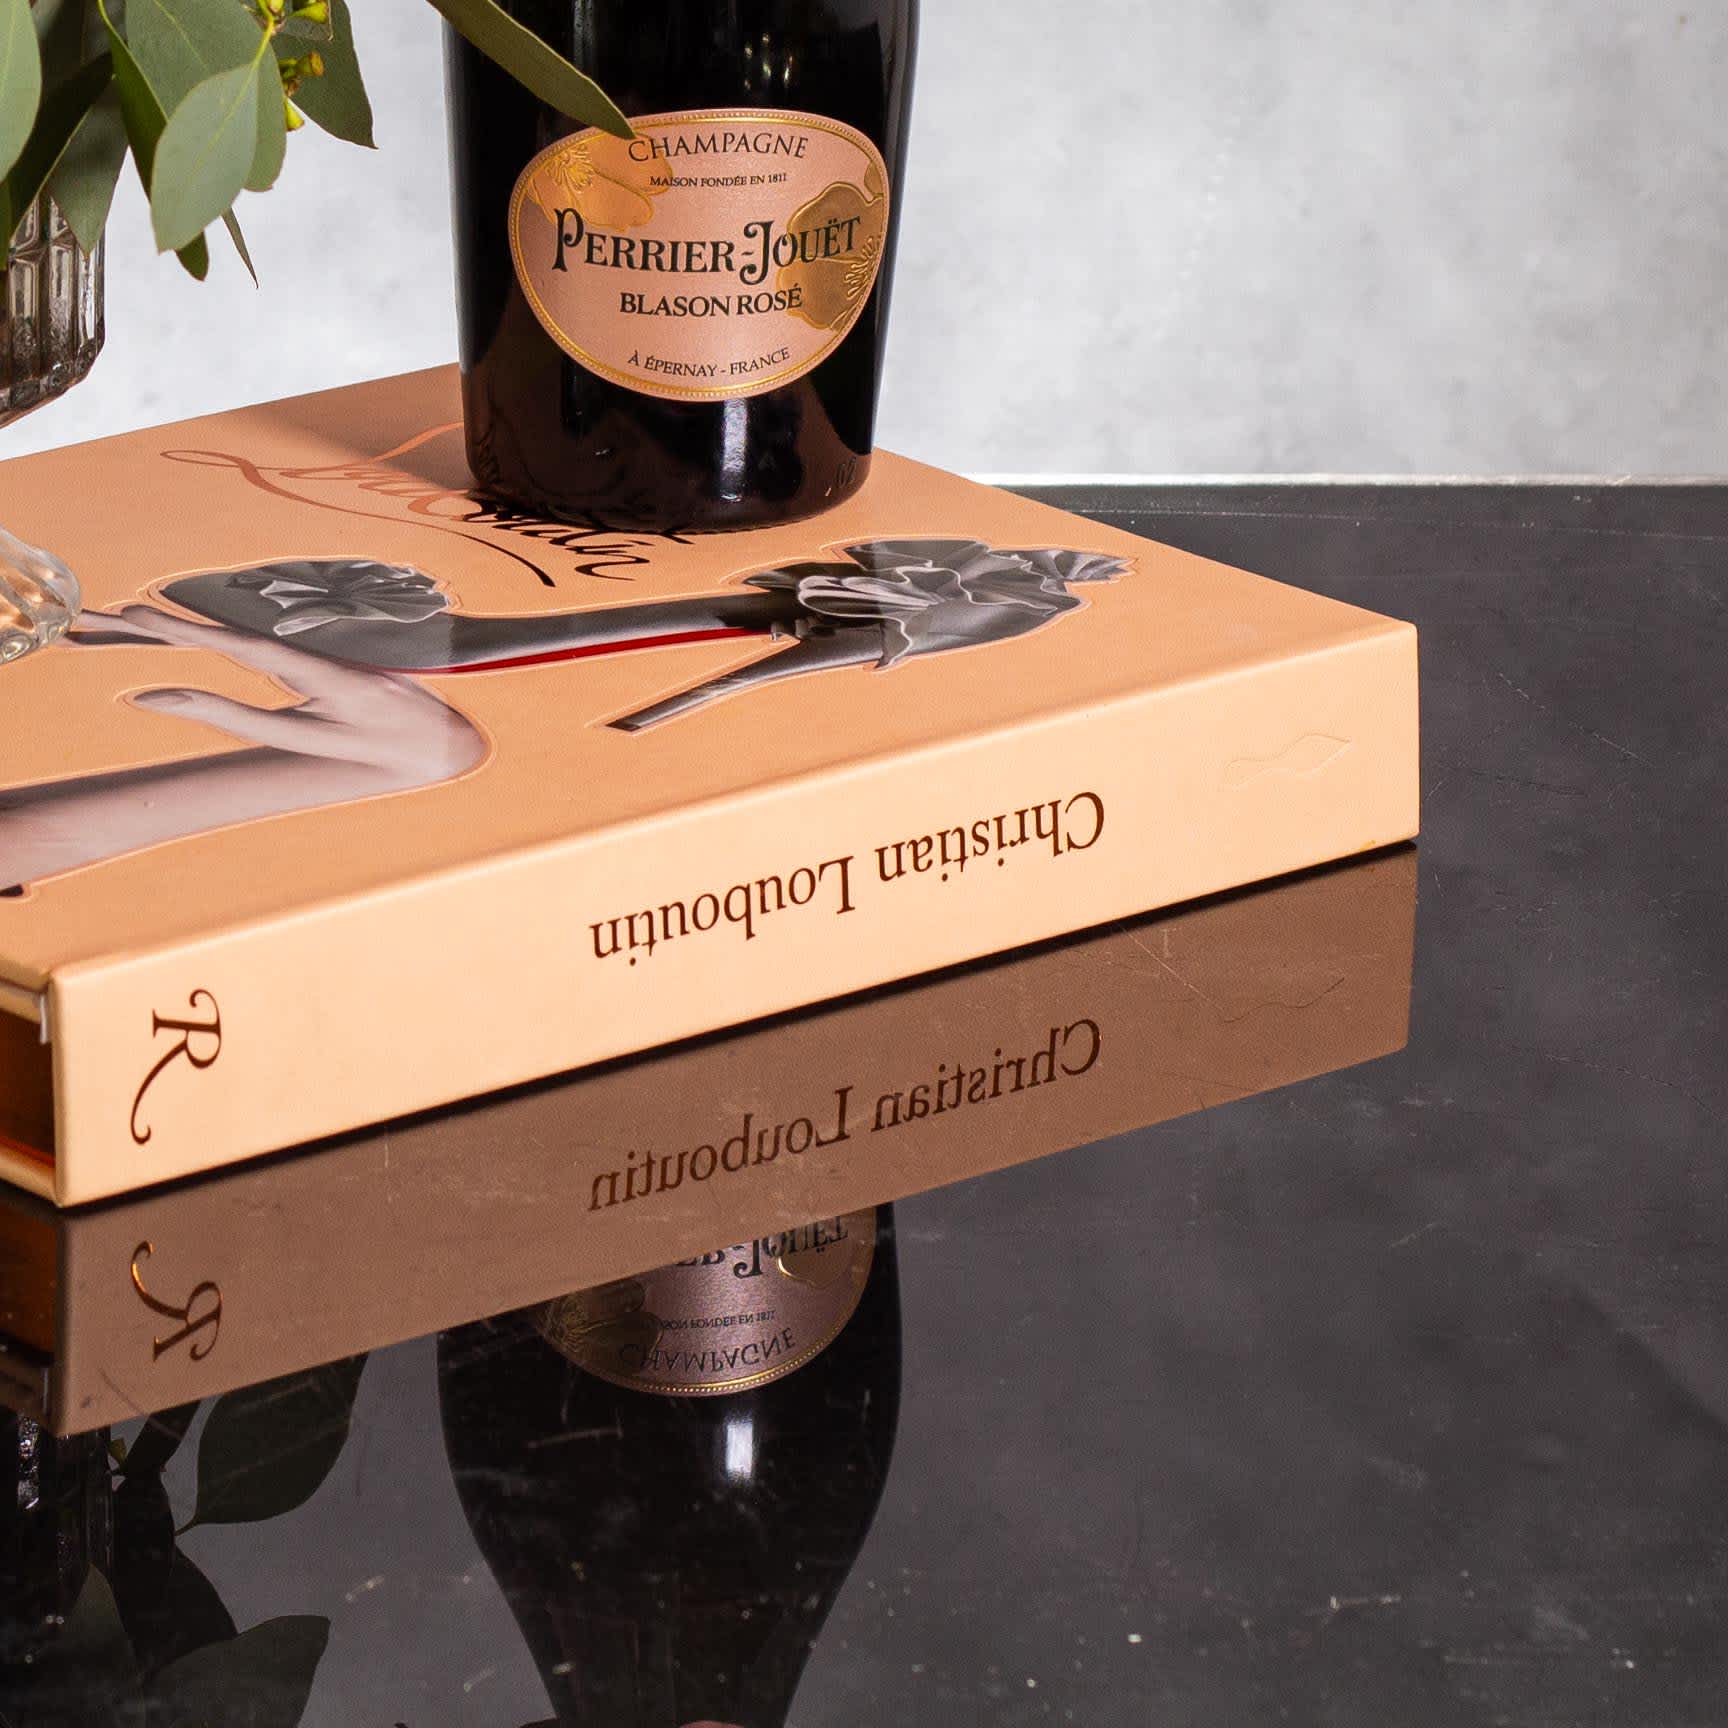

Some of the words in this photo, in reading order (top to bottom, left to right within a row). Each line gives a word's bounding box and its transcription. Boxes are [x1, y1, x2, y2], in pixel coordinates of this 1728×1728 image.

[627, 132, 809, 162] CHAMPAGNE
[649, 175, 698, 188] MAISON
[700, 174, 747, 188] FONDÉE
[749, 174, 766, 185] EN
[768, 172, 788, 184] 1811
[551, 207, 863, 286] PERRIER-JOUËT
[619, 291, 732, 318] BLASON
[735, 282, 803, 316] ROSÉ
[627, 349, 640, 367] À
[643, 354, 718, 377] ÉPERNAY
[729, 346, 791, 376] FRANCE
[874, 791, 1105, 883] Christian
[588, 855, 855, 967] Louboutin
[130, 988, 222, 1145] R
